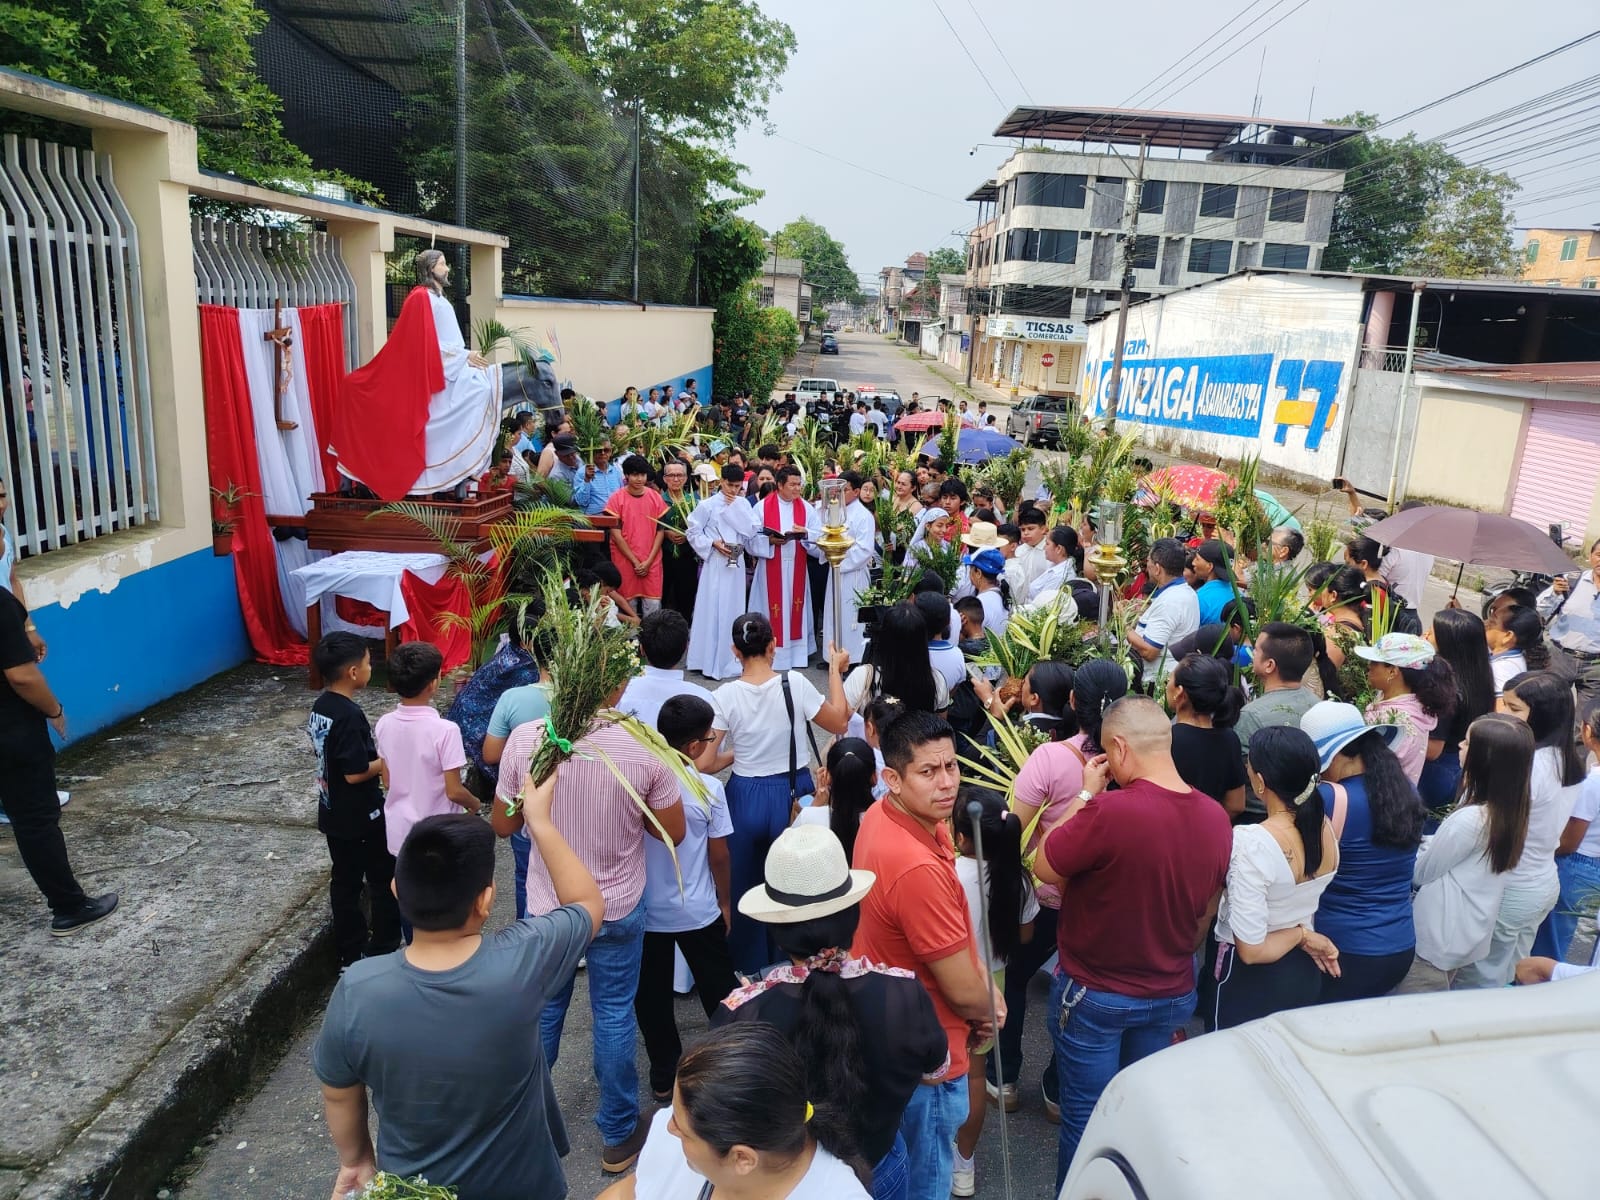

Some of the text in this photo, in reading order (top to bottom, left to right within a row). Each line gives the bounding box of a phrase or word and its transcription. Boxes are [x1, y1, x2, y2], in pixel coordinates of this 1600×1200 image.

[1025, 321, 1074, 334] TICSAS
[1028, 332, 1069, 341] COMERCIAL
[1195, 372, 1263, 421] ASAMBLEISTA
